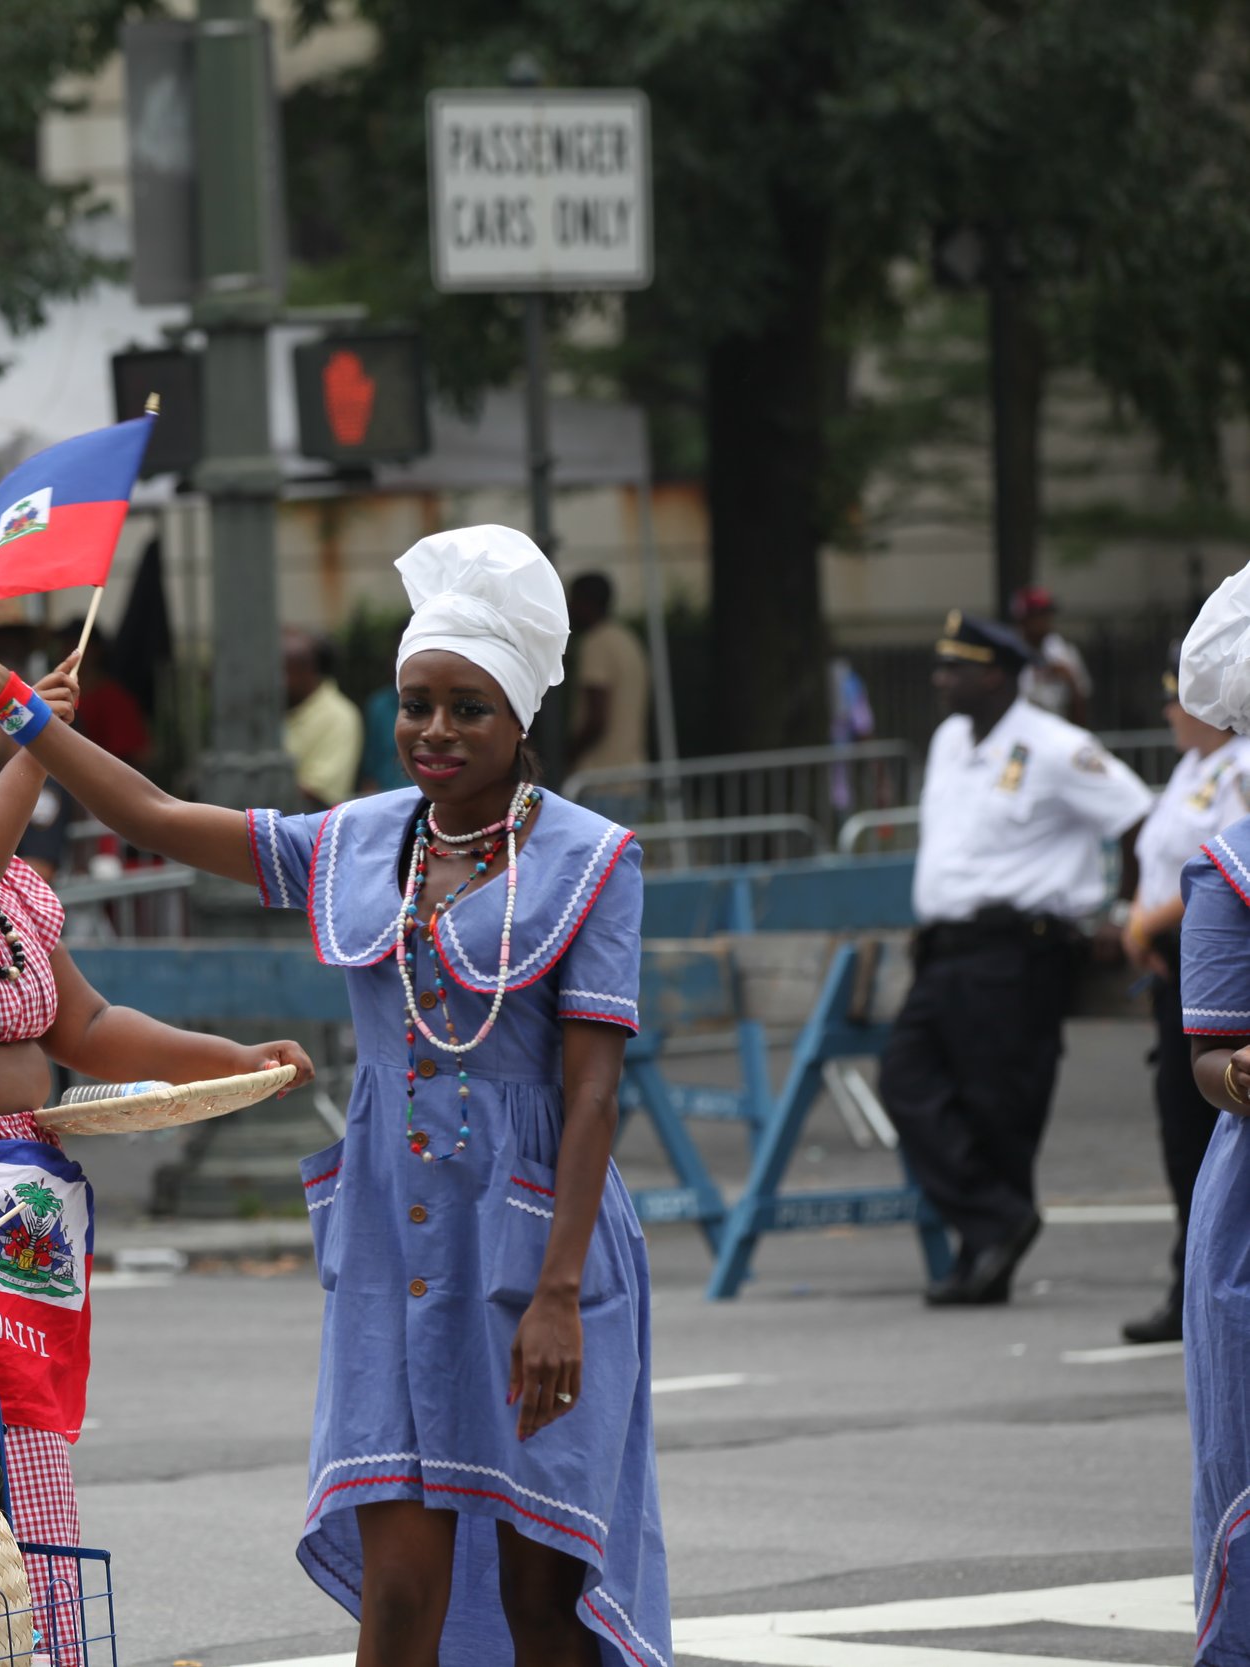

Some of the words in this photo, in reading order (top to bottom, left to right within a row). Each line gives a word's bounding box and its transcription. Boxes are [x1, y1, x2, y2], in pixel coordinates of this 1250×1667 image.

[449, 123, 630, 178] PASSENGER
[452, 195, 535, 249] CARS
[552, 195, 632, 249] ONLY
